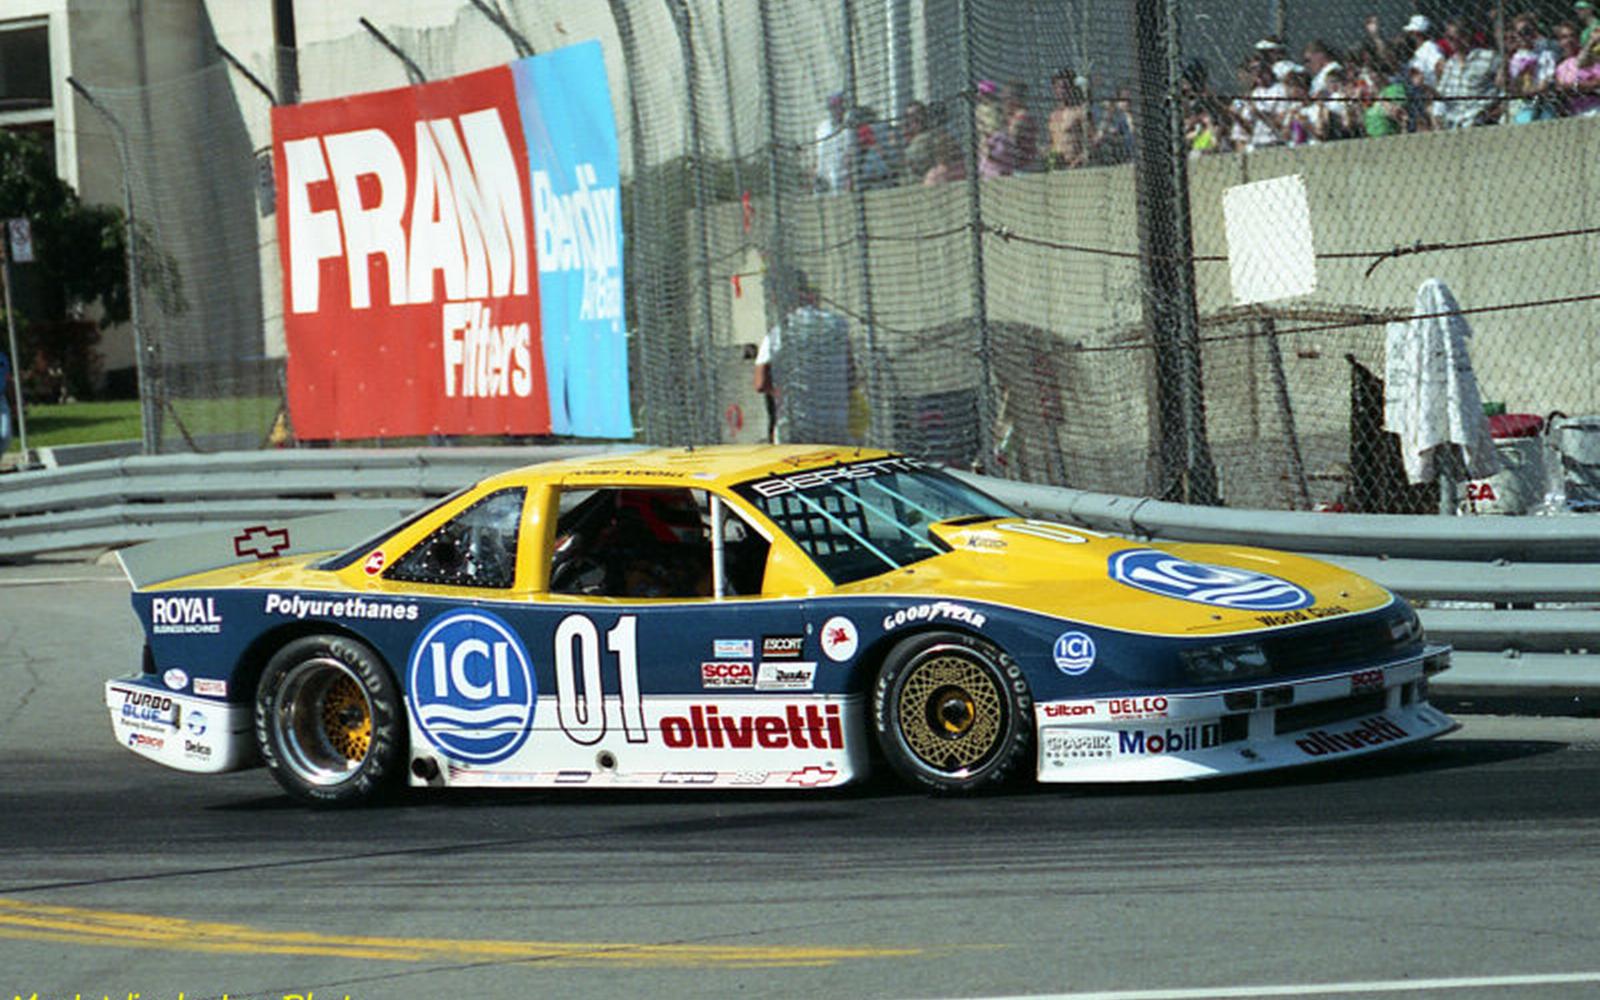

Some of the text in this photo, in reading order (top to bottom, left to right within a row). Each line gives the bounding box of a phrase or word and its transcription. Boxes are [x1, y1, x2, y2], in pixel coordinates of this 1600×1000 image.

[283, 107, 529, 313] FRAM
[442, 301, 532, 398] Filters
[153, 598, 222, 624] ROYAL
[265, 594, 419, 620] Polyurethanes
[883, 602, 987, 631] GOODYEAR
[1061, 639, 1088, 657] ICI
[431, 640, 510, 700] ICI
[553, 613, 649, 746] 01
[703, 664, 752, 678] SCCA
[111, 687, 172, 711] TURBO
[122, 704, 162, 720] BLUE
[1044, 704, 1095, 717] tilton
[1109, 698, 1168, 714] DELCO
[659, 705, 844, 749] olivetti
[1296, 716, 1409, 756] olivetti
[1119, 727, 1197, 754] Mobil
